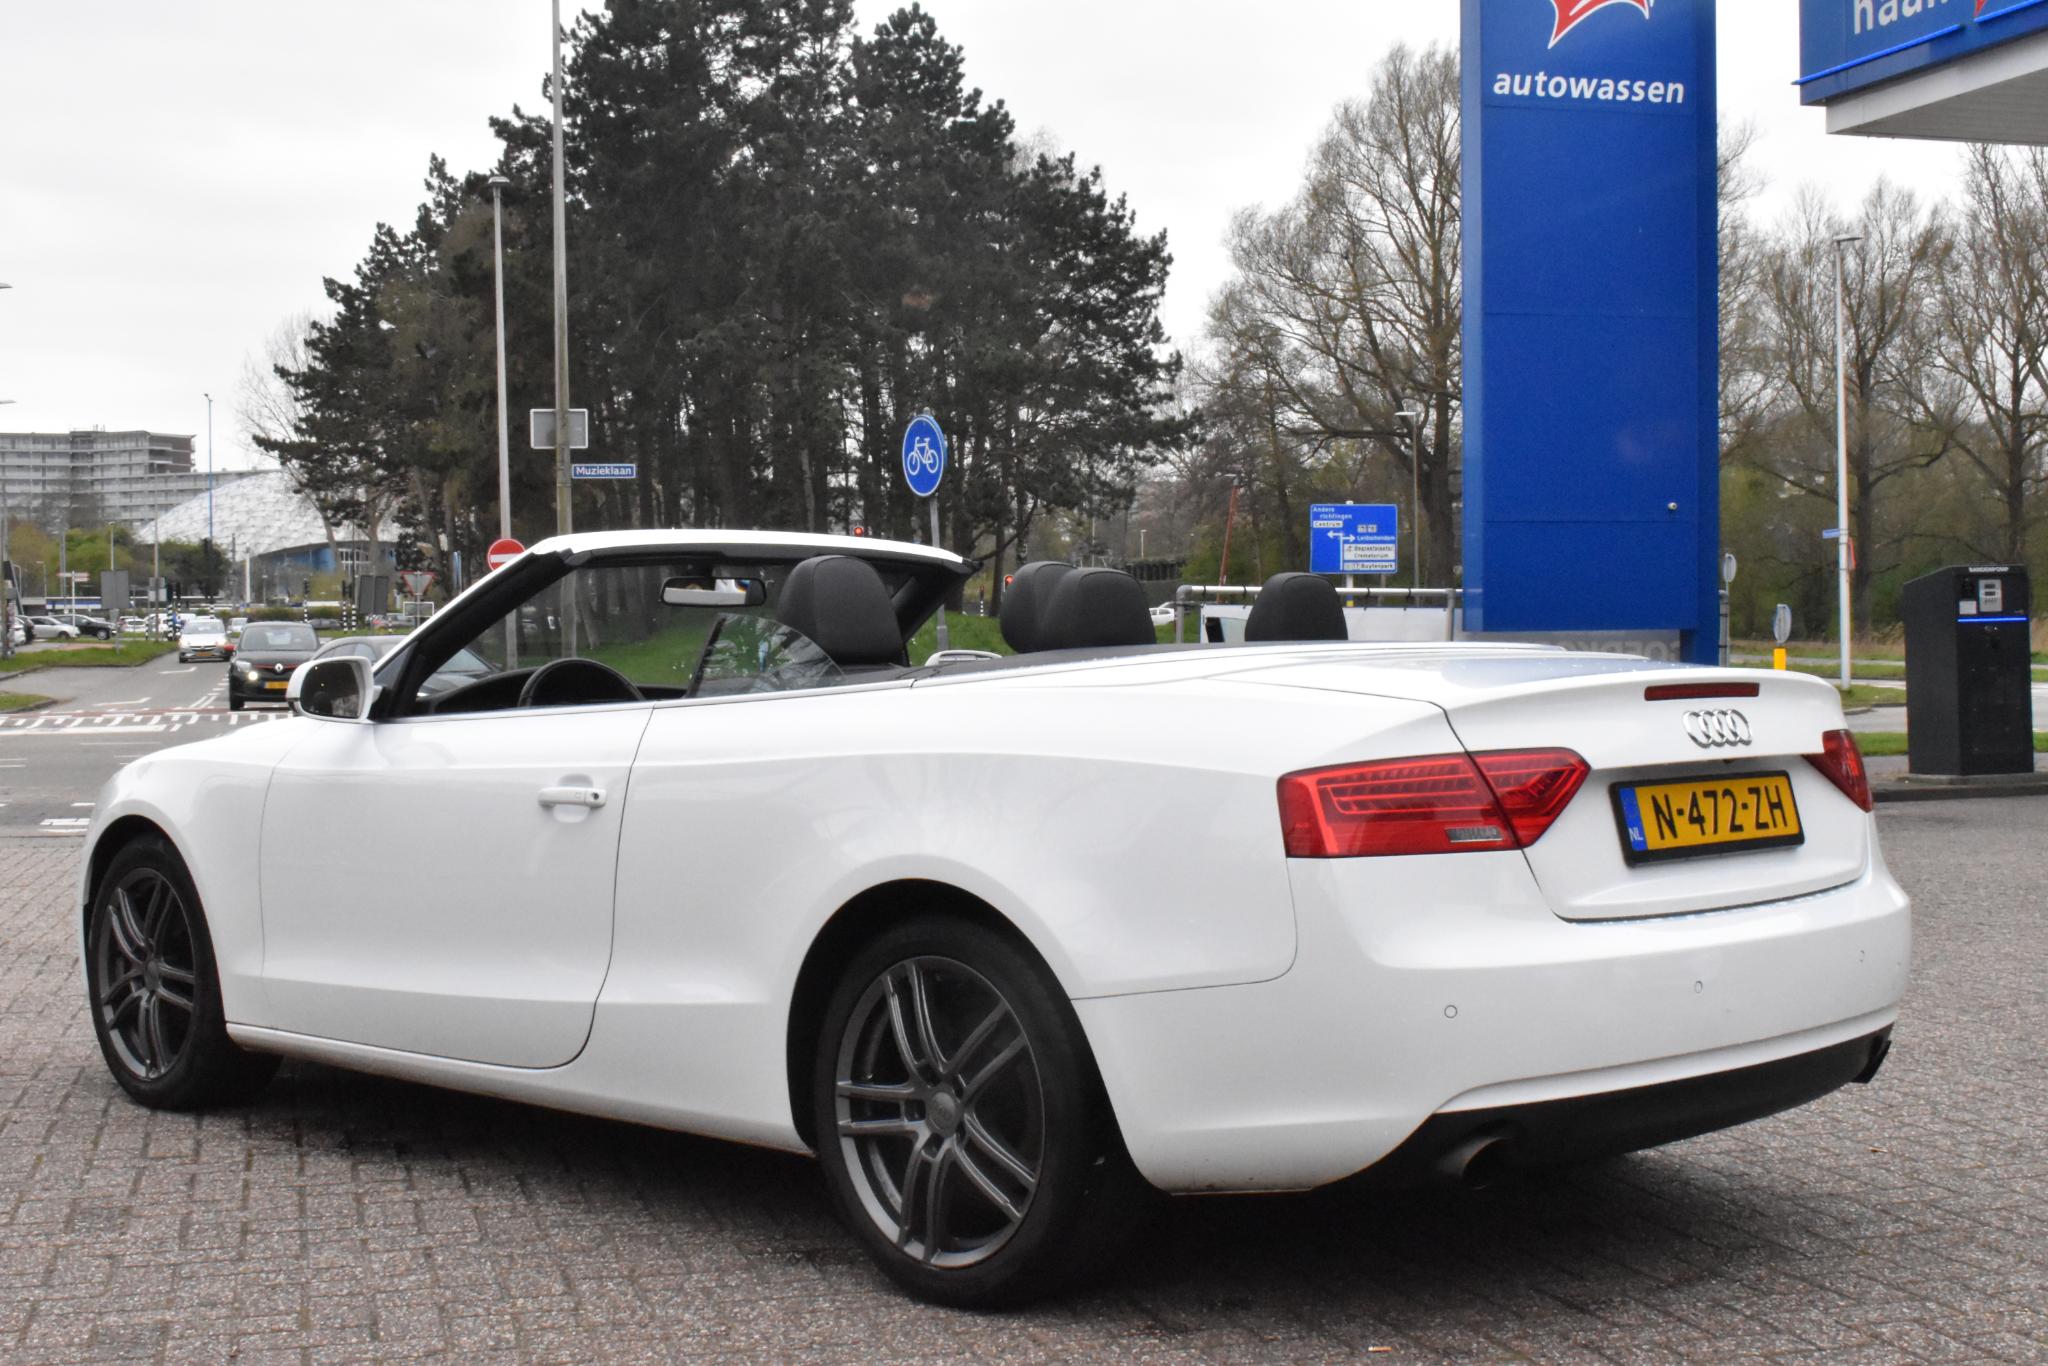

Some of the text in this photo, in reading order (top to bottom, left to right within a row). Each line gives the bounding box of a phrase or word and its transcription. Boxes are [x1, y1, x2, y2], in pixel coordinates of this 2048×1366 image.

[1493, 71, 1685, 103] autowassen
[576, 466, 632, 475] Muzieklaan
[1651, 785, 1788, 840] N-472-ZH
[1628, 826, 1644, 841] NL
